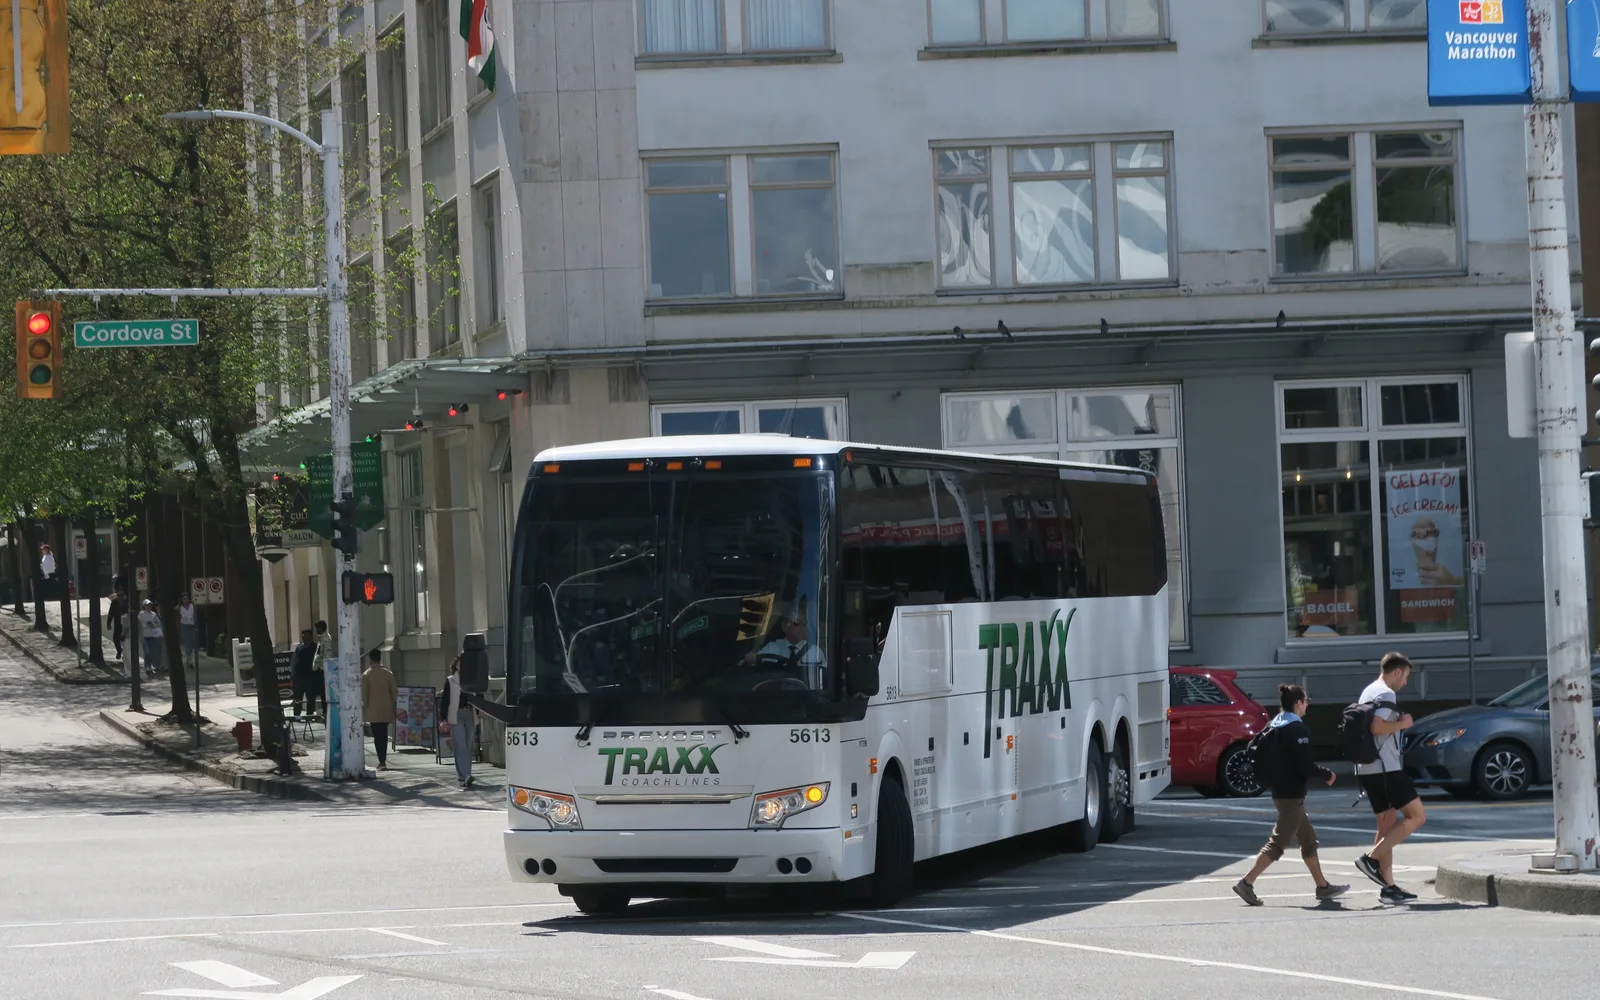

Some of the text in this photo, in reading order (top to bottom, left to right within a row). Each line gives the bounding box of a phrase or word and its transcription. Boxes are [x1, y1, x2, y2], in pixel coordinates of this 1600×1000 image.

[1445, 31, 1518, 44] Vancouver
[1448, 45, 1516, 59] Marathon
[81, 323, 192, 342] Cordova St
[1390, 502, 1411, 518] ICE
[288, 532, 314, 541] SALON
[1307, 602, 1354, 613] BAGEL
[1400, 598, 1455, 608] SANDWICH
[979, 608, 1077, 759] TRAXX
[506, 731, 538, 746] 5613
[603, 730, 721, 742] PREVOST
[789, 728, 831, 744] 5613
[598, 743, 729, 786] TRAXX
[621, 777, 721, 786] COACHLINES
